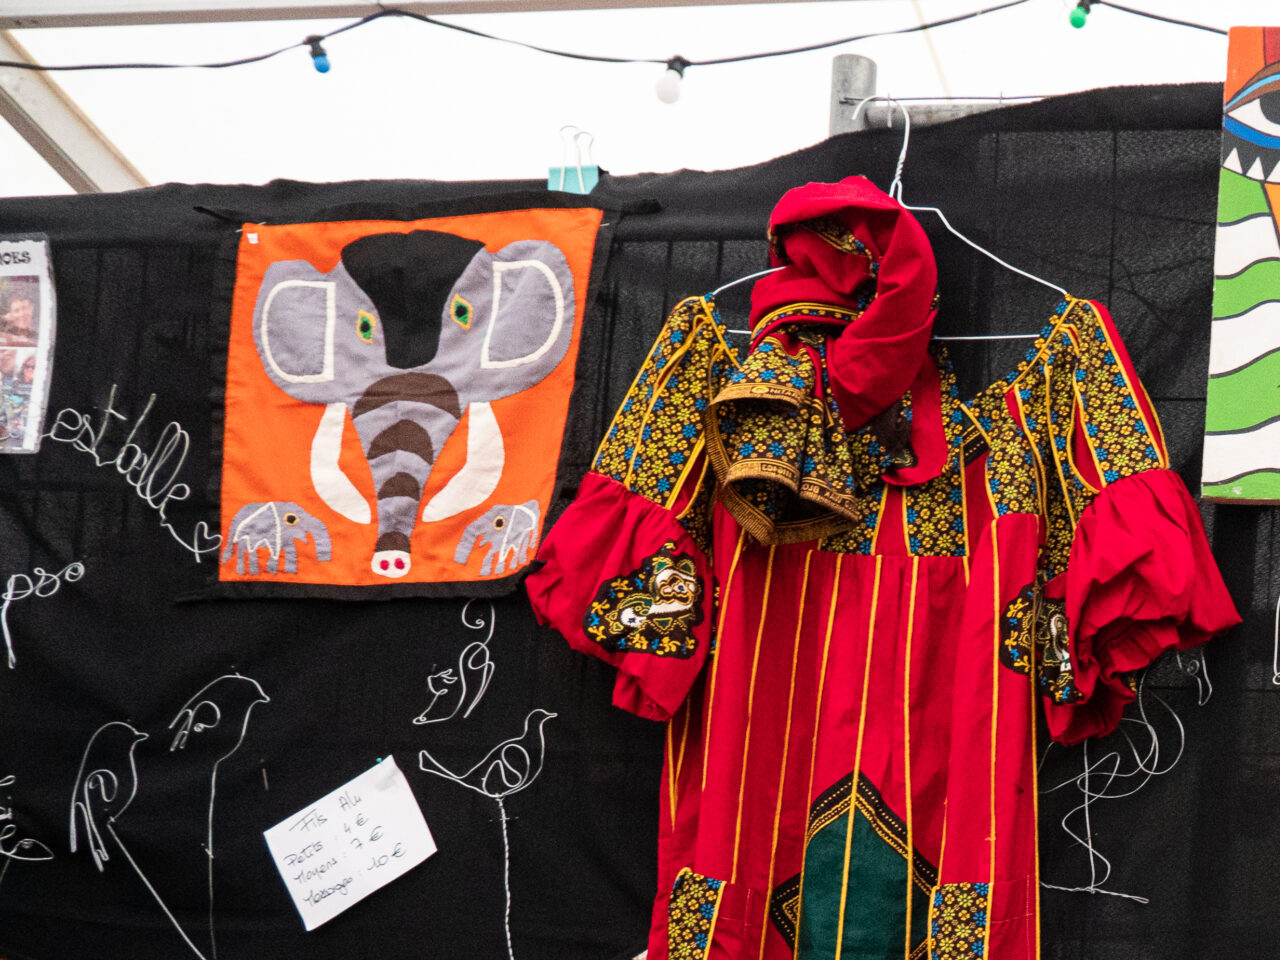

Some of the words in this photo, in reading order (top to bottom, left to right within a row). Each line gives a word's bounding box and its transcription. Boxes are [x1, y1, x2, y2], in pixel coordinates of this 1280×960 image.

[0, 251, 31, 265] OES
[288, 808, 328, 832] Fils
[338, 790, 363, 812] Alu
[350, 837, 363, 849] 7
[283, 841, 324, 867] Petits
